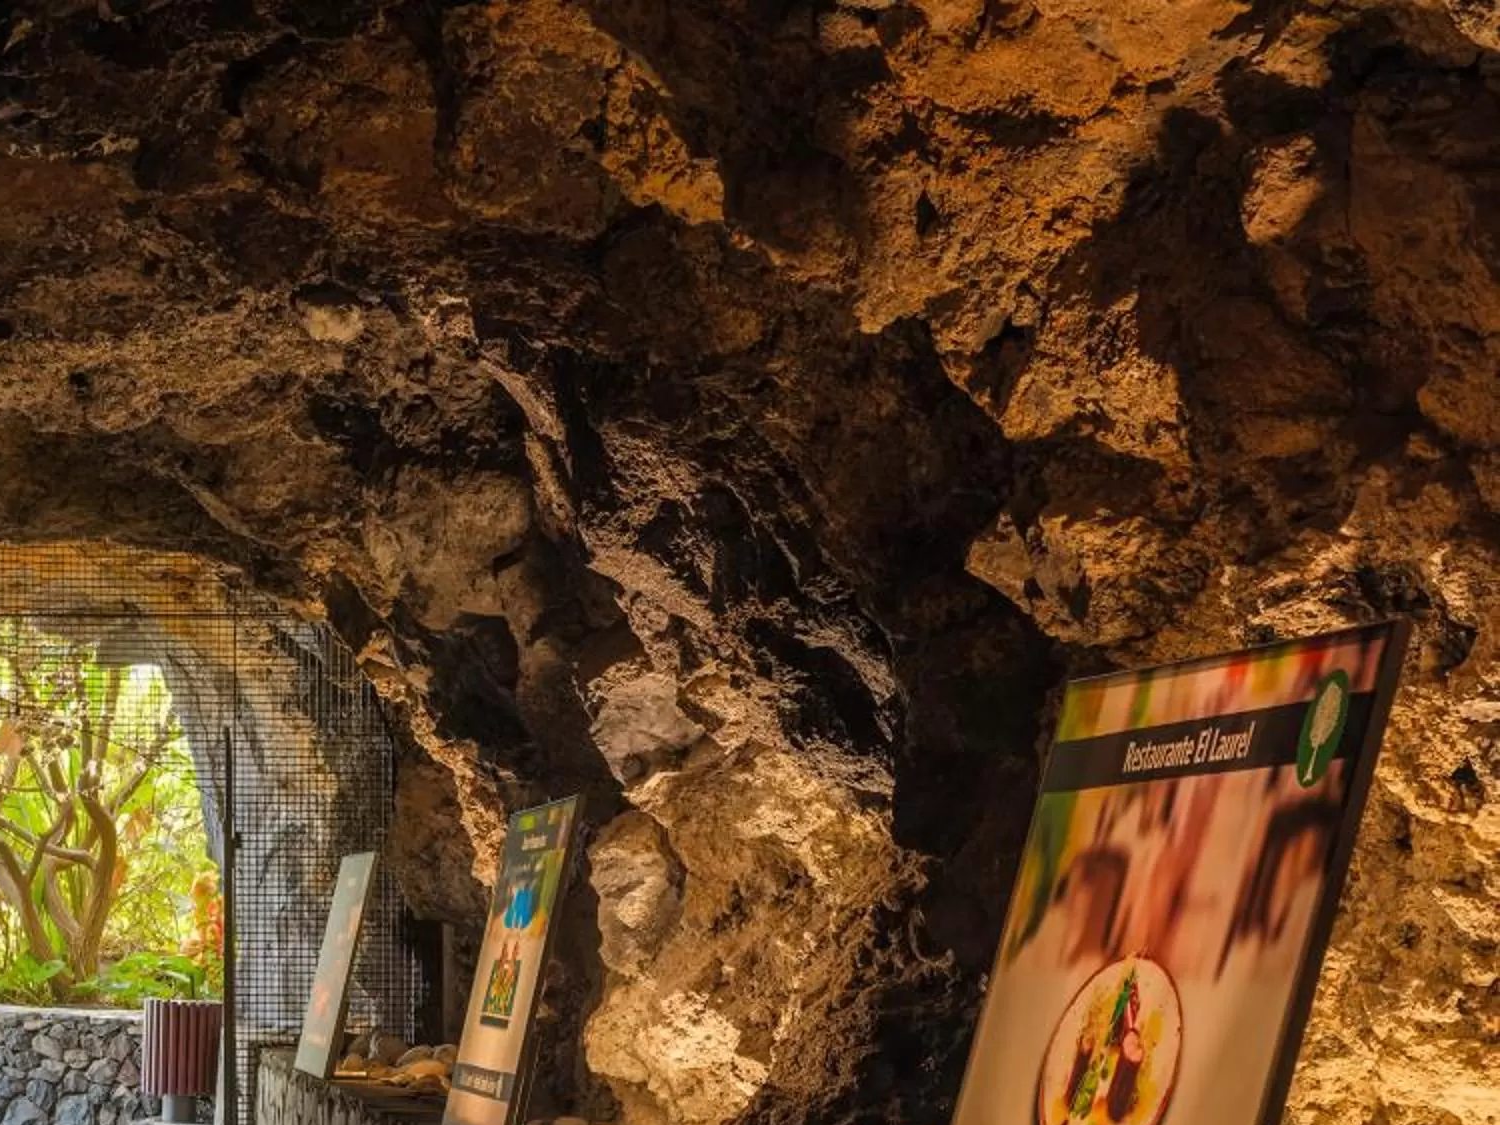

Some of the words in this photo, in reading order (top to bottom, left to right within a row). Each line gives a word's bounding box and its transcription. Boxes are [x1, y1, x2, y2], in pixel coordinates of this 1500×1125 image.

[1122, 736, 1194, 773] Restaurante
[1193, 726, 1212, 764] El
[1207, 720, 1256, 762] Laurel
